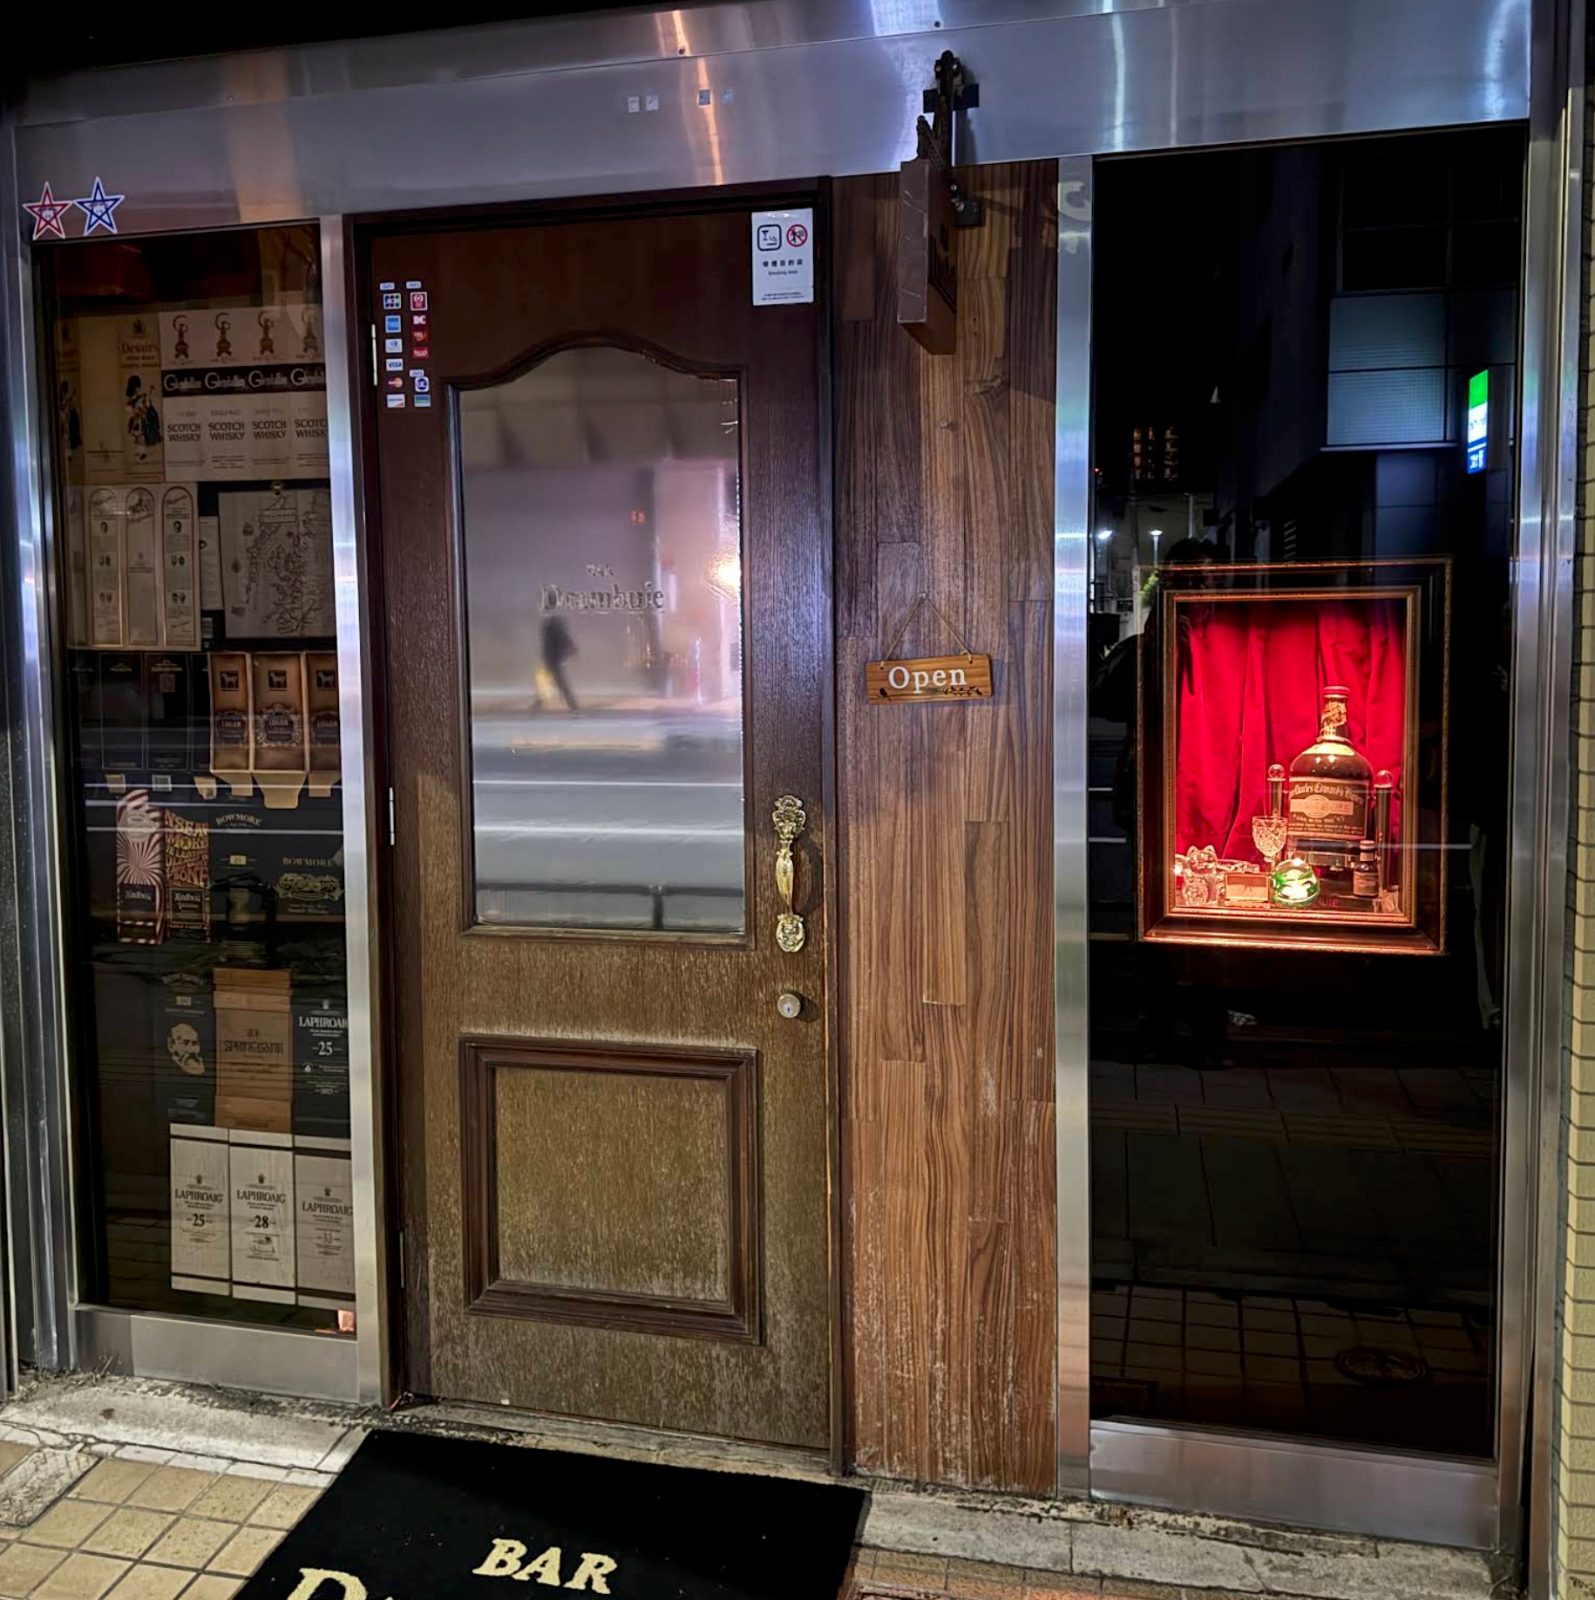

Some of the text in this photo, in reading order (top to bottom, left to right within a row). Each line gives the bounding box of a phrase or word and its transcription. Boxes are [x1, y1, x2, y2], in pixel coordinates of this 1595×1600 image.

[167, 423, 201, 433] SCOTCH
[208, 421, 245, 431] SCOTCH
[252, 419, 288, 430] SCOTCH
[295, 418, 327, 429] SCOTC
[168, 432, 201, 443] WHISKY
[209, 431, 246, 442] WHISKY
[253, 429, 288, 441] WHISKY
[295, 428, 327, 440] WHISK
[888, 665, 967, 694] Open
[215, 812, 263, 826] BOWMORE
[282, 856, 334, 867] BOWMORE
[318, 1041, 333, 1056] 25
[174, 1188, 224, 1204] LAPHROAIG
[236, 1189, 287, 1204] LAPHROAIG
[192, 1213, 206, 1228] 25
[254, 1215, 270, 1229] 28
[472, 1537, 618, 1595] BAR
